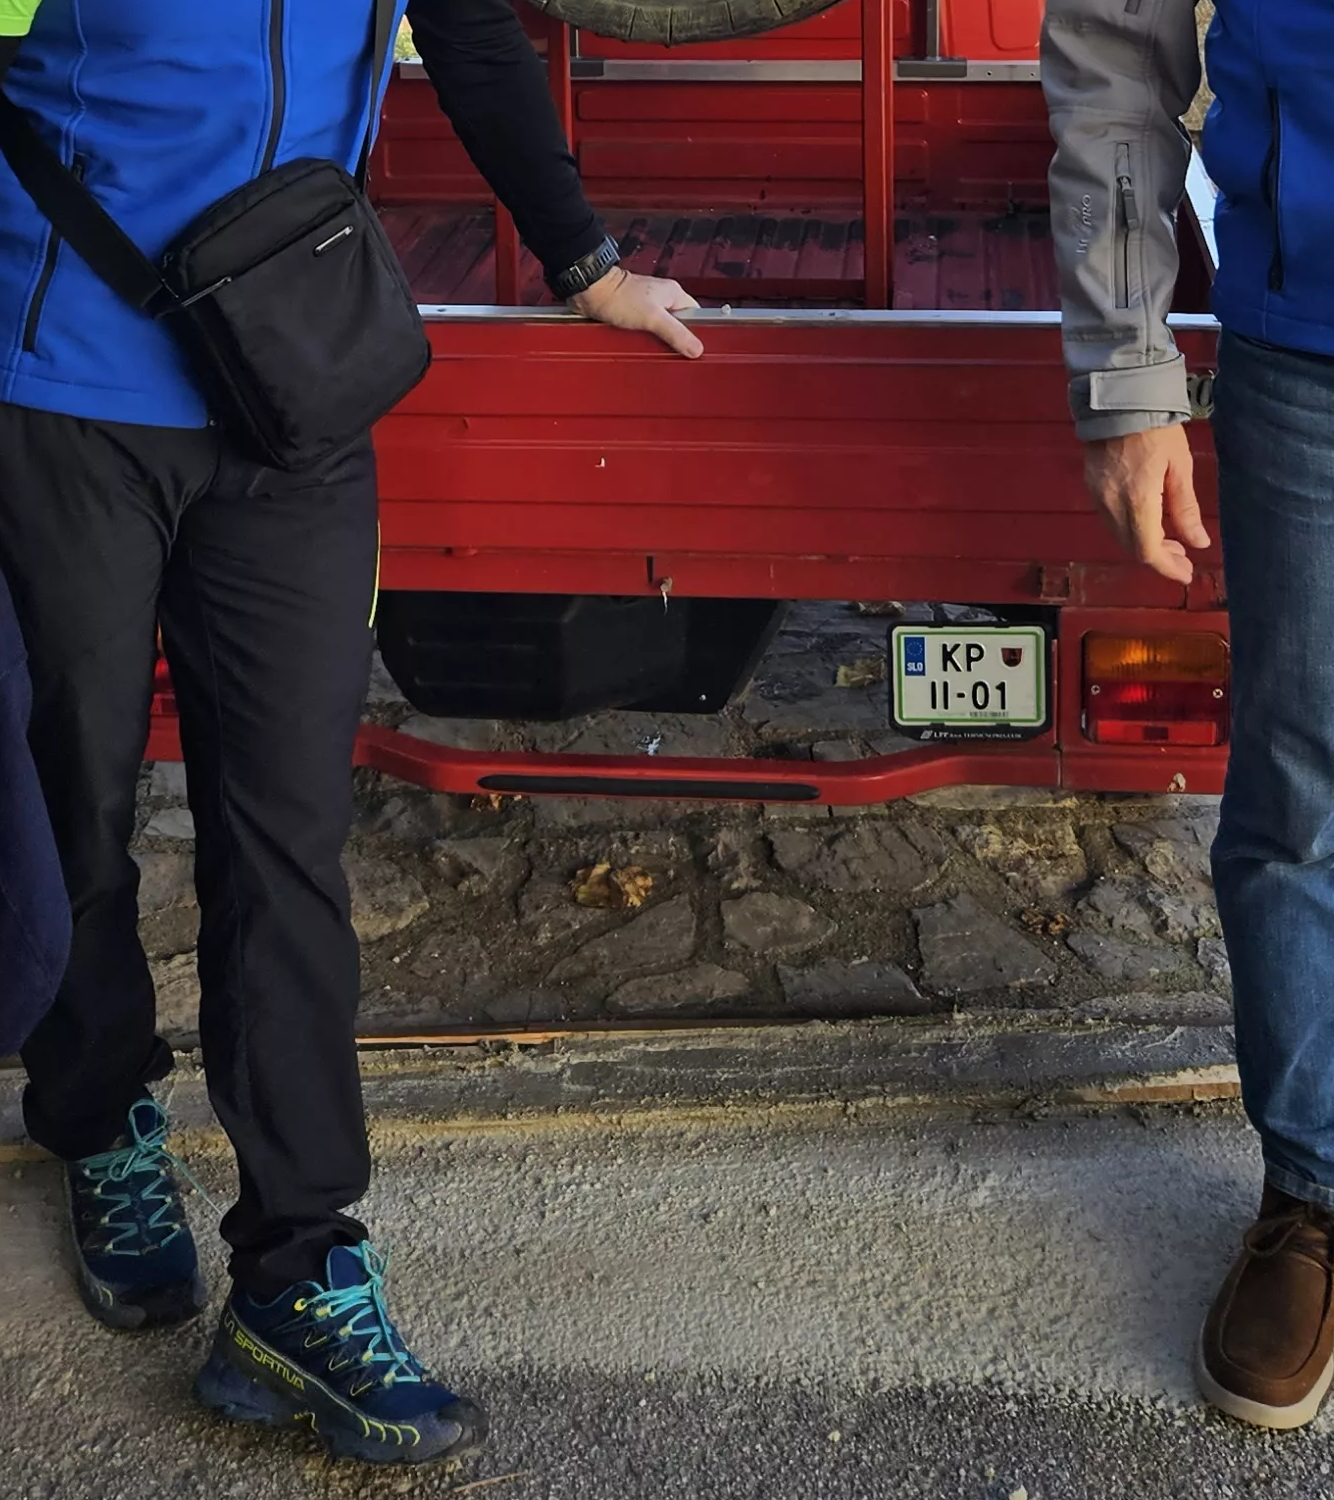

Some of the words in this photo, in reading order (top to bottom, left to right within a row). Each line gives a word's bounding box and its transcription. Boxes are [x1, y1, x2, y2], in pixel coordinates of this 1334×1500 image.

[907, 662, 923, 671] SLO
[942, 643, 984, 672] KP
[234, 1330, 305, 1391] SPORTIVA
